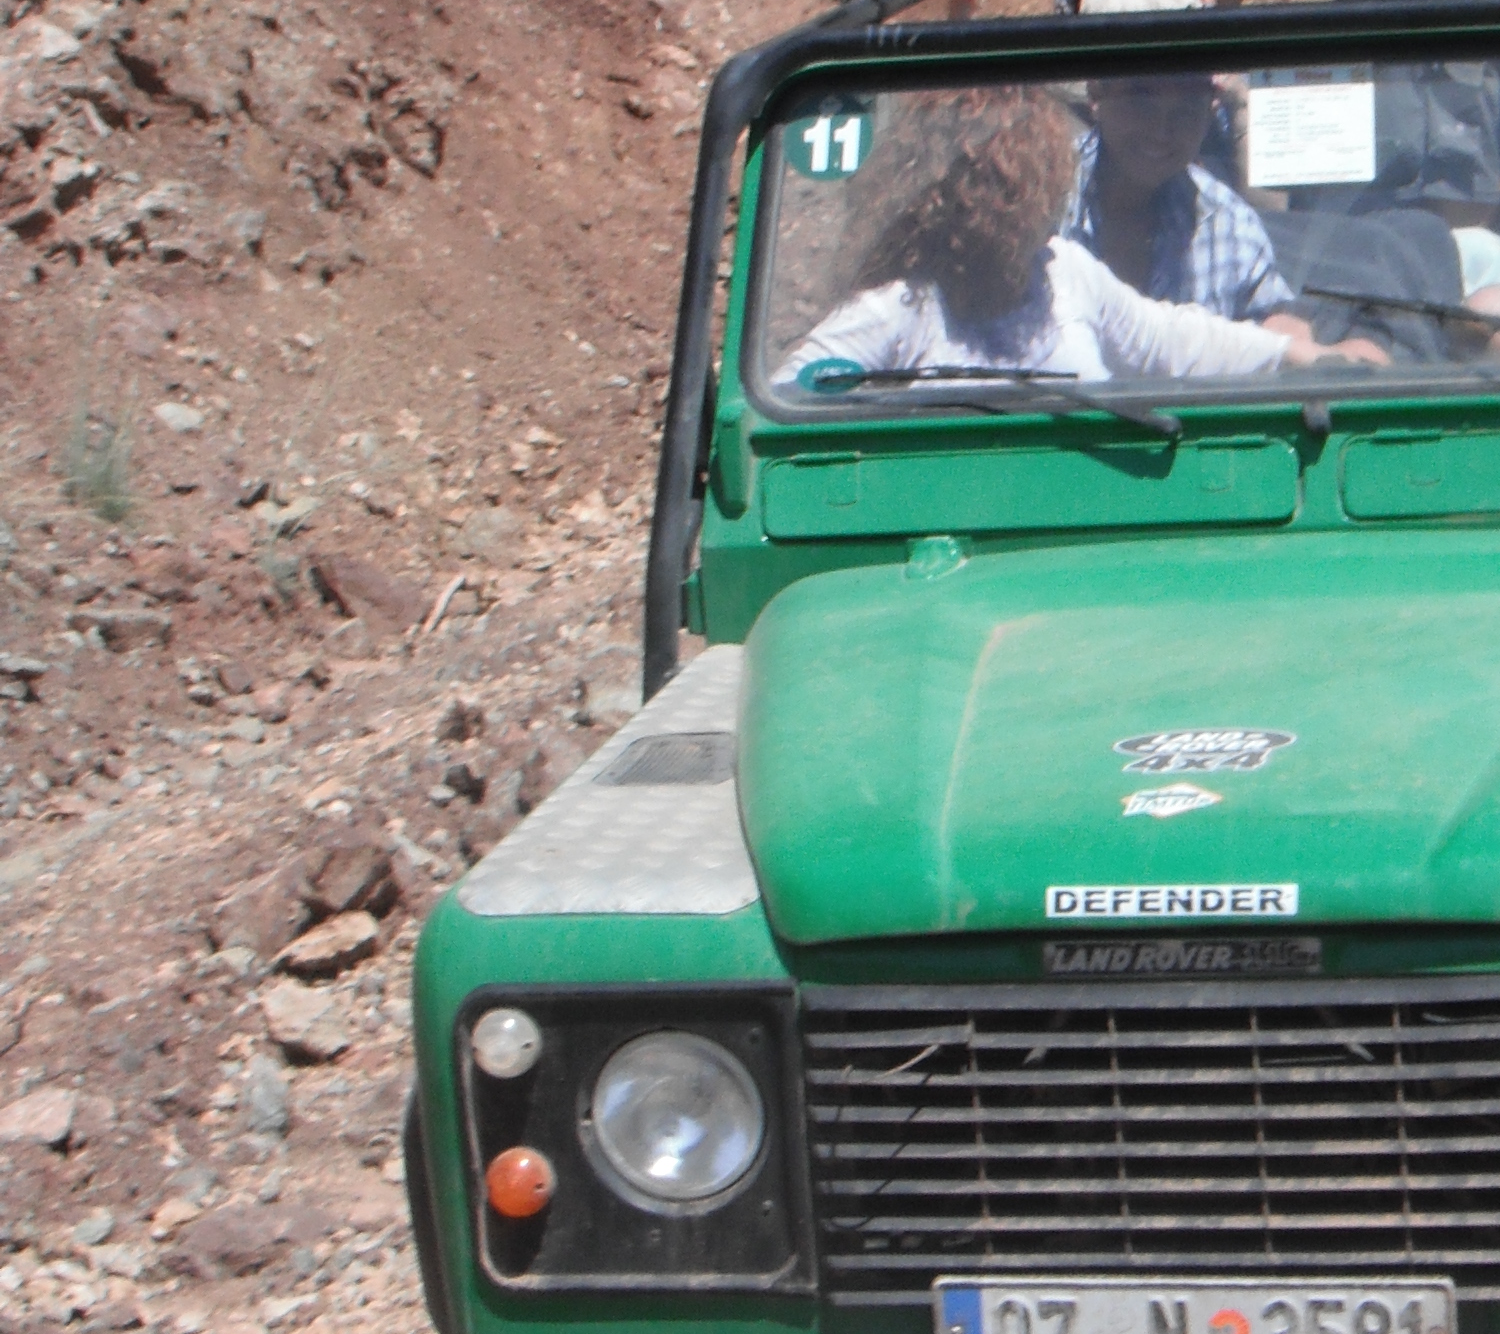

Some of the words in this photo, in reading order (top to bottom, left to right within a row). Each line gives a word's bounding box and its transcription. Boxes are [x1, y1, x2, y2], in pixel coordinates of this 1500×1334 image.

[803, 117, 861, 172] 11
[1054, 889, 1285, 914] DEFENDER
[1051, 947, 1131, 973] LAND
[1134, 945, 1233, 971] ROVER
